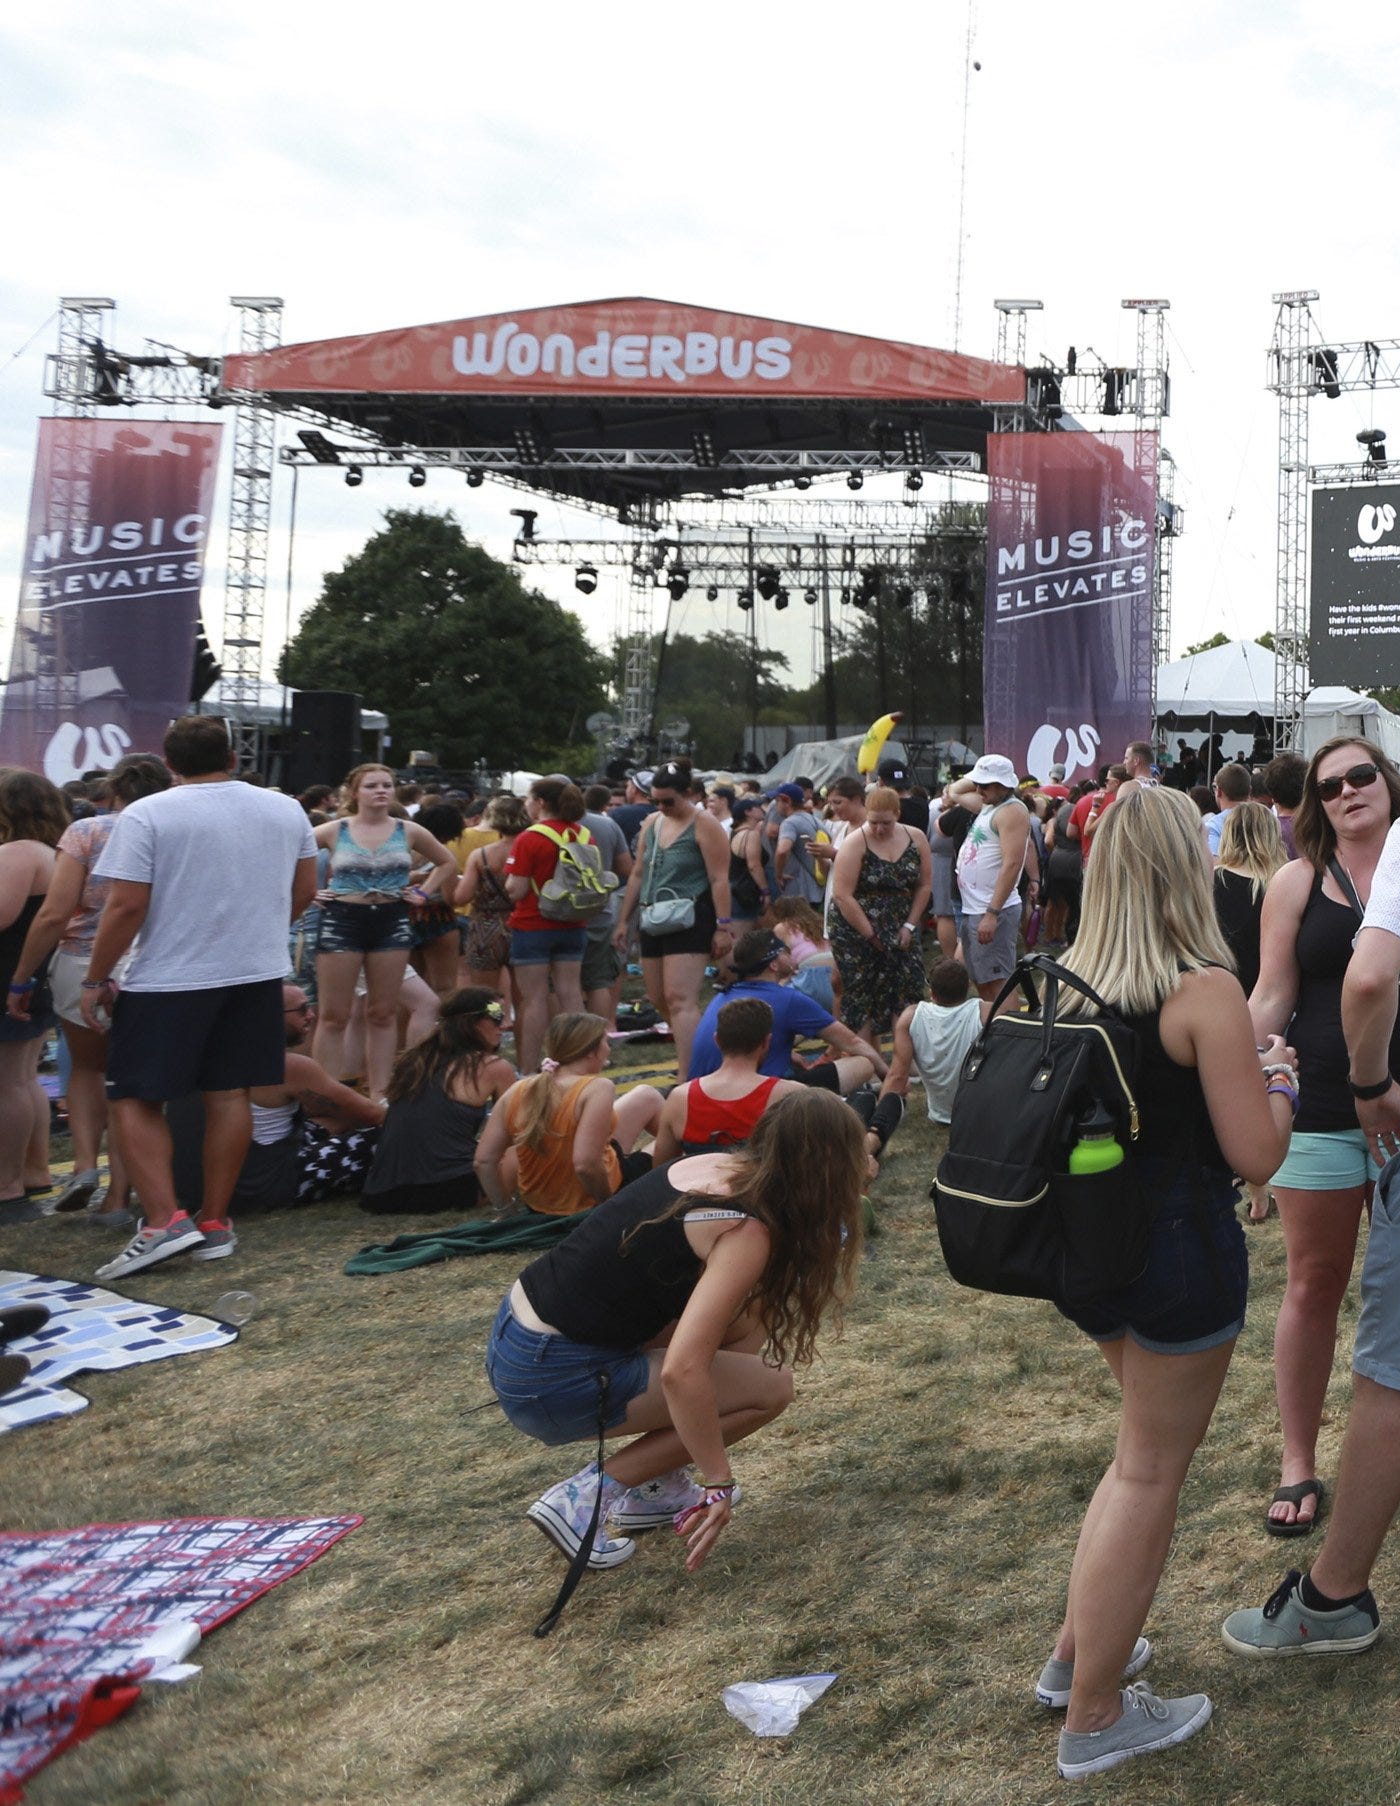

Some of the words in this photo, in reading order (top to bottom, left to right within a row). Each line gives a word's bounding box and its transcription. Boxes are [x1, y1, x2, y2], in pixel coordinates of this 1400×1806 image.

[30, 514, 208, 563] MUSIC
[997, 519, 1148, 576] MUSIC
[25, 561, 202, 601] ELEVATES
[996, 564, 1148, 612] ELEVATES
[1328, 605, 1347, 614] Have
[1348, 604, 1361, 613] the
[1361, 603, 1377, 613] kids
[1328, 615, 1346, 625] their
[1347, 615, 1362, 624] first
[1363, 614, 1397, 623] weekend
[1328, 627, 1344, 636] first
[1344, 627, 1360, 637] year
[1360, 626, 1369, 634] in
